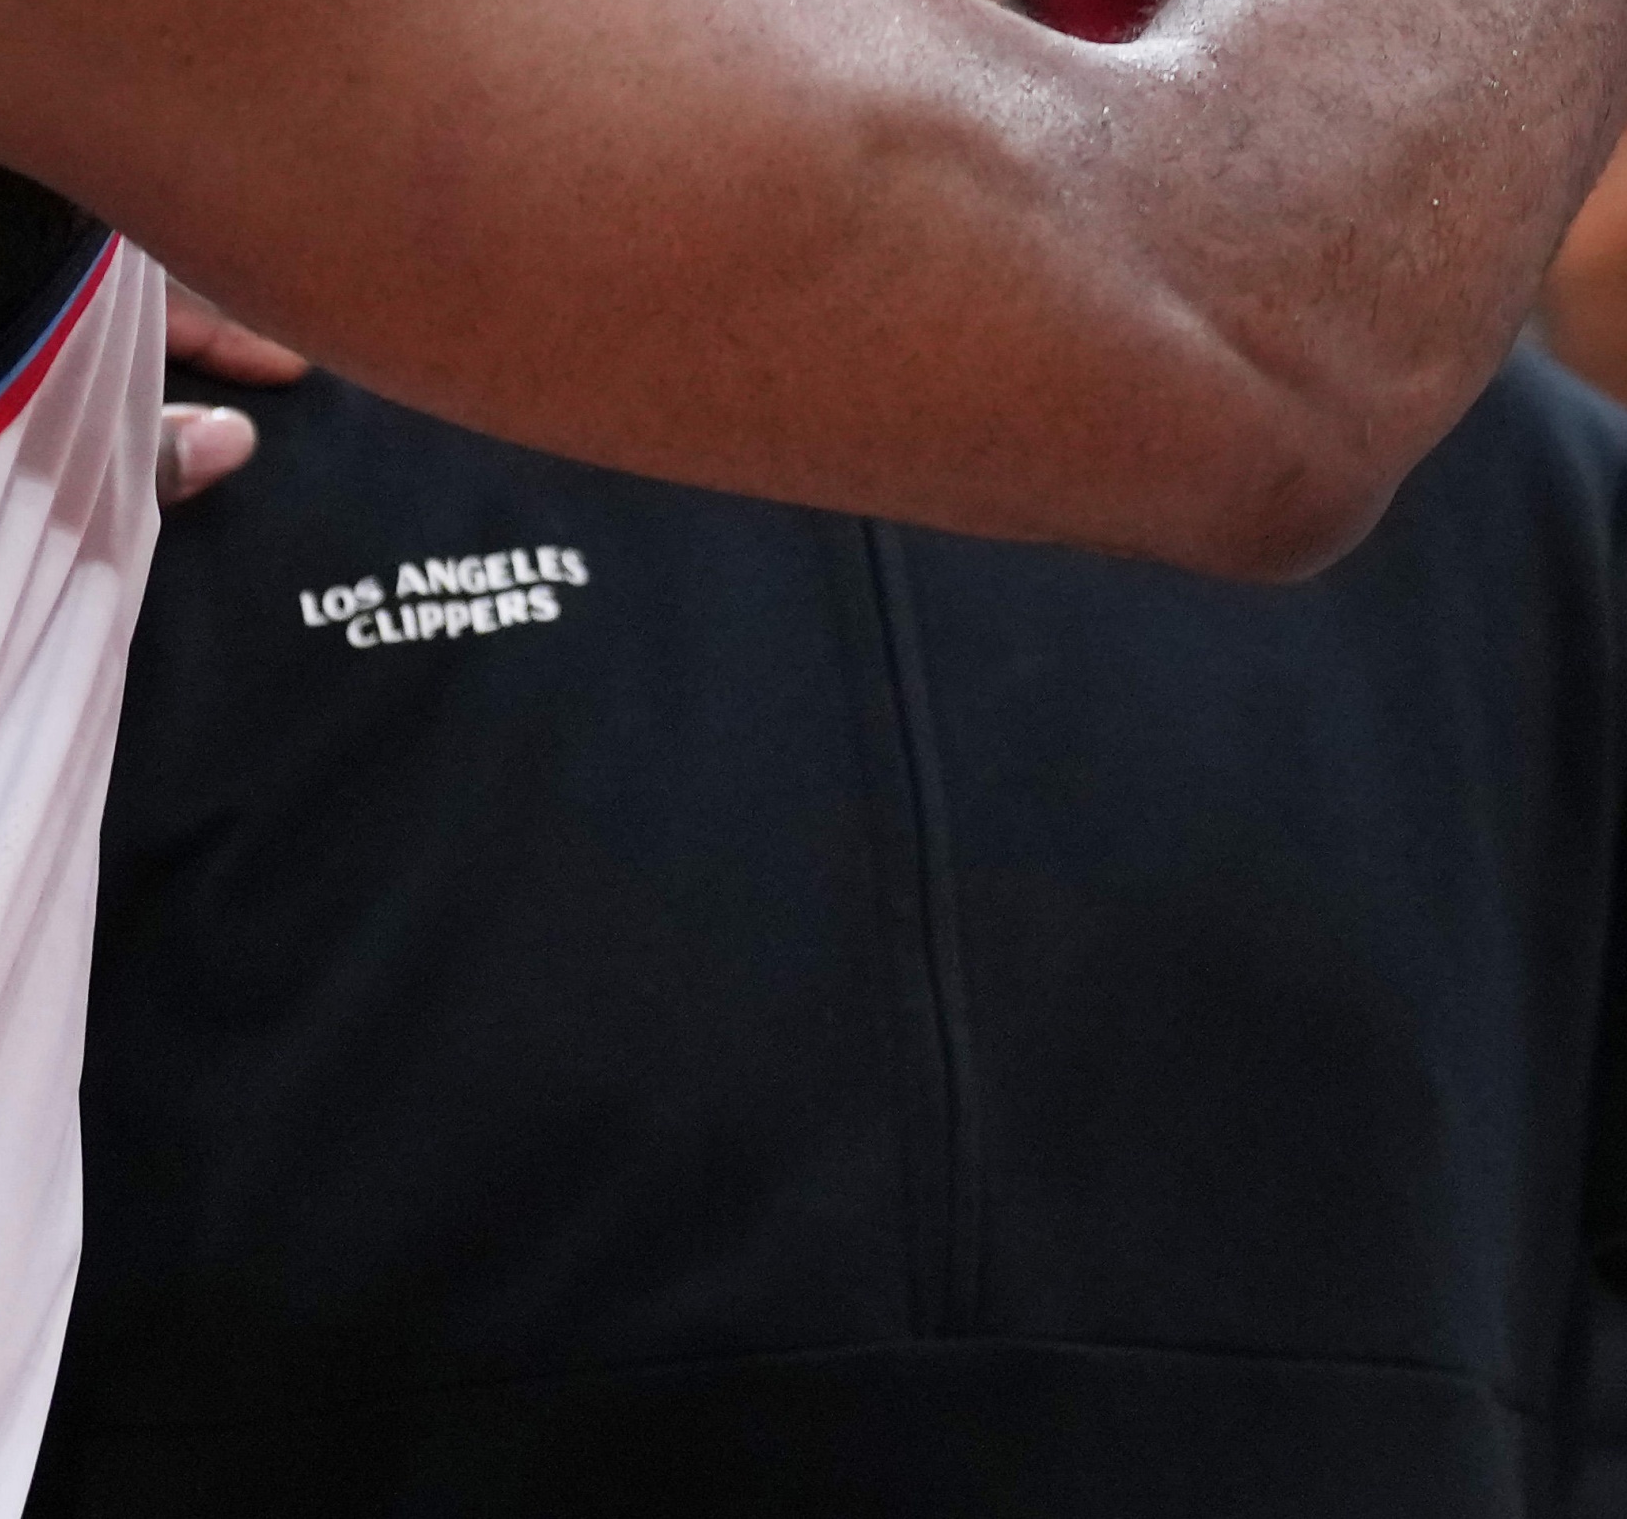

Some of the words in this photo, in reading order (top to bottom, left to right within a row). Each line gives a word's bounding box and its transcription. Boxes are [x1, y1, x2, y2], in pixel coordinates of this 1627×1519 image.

[299, 575, 385, 627] LOS
[395, 544, 590, 587] ANGELES
[345, 583, 561, 649] CLIPPERS
